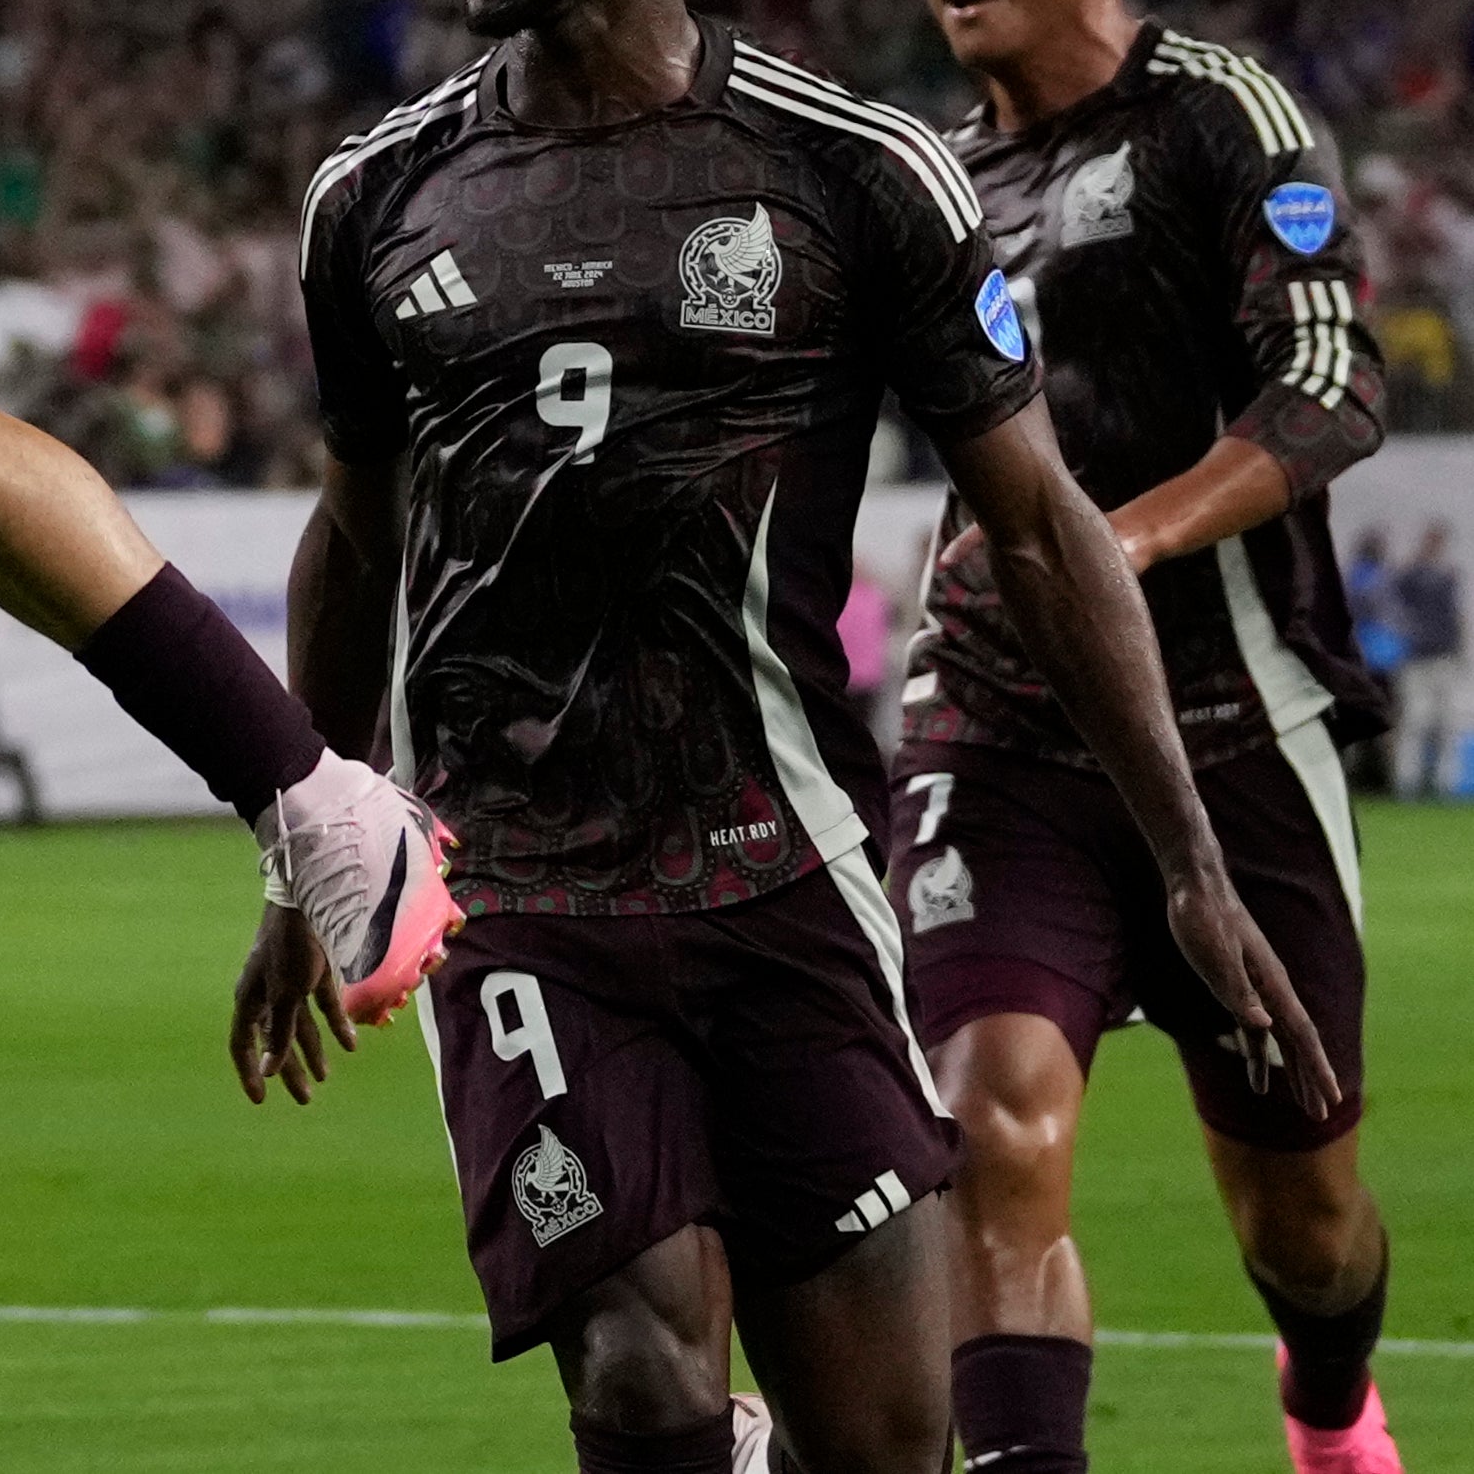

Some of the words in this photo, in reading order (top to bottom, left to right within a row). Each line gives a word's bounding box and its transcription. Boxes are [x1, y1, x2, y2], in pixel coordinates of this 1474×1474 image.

[685, 303, 771, 329] MÉXICO
[536, 342, 613, 465] 9
[710, 820, 777, 846] HEAT.RDY
[906, 772, 955, 845] 7
[480, 971, 568, 1100] 9
[537, 1200, 598, 1242] MÉXICO
